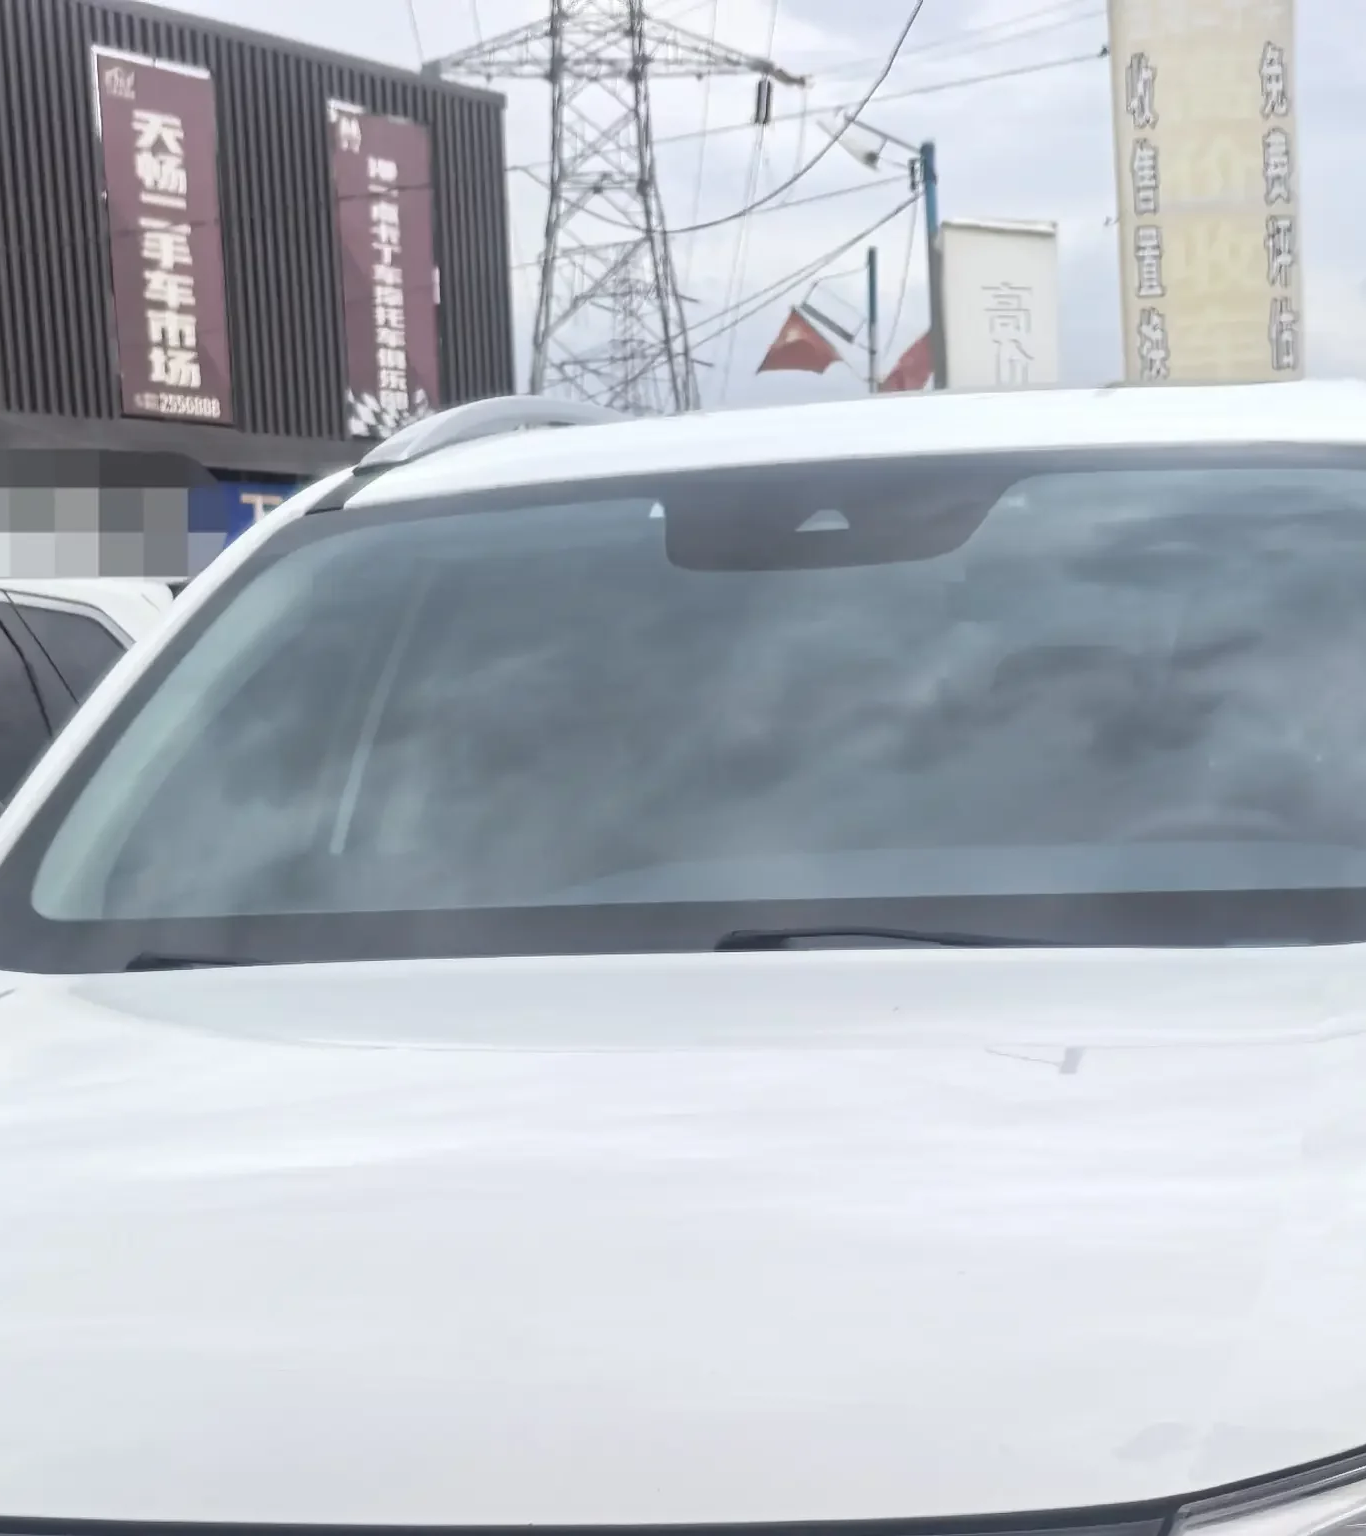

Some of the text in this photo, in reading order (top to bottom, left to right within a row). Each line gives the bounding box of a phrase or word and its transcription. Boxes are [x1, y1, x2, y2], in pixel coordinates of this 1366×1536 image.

[132, 109, 202, 388] 天畅二手车市场
[1256, 40, 1300, 371] 免费评估
